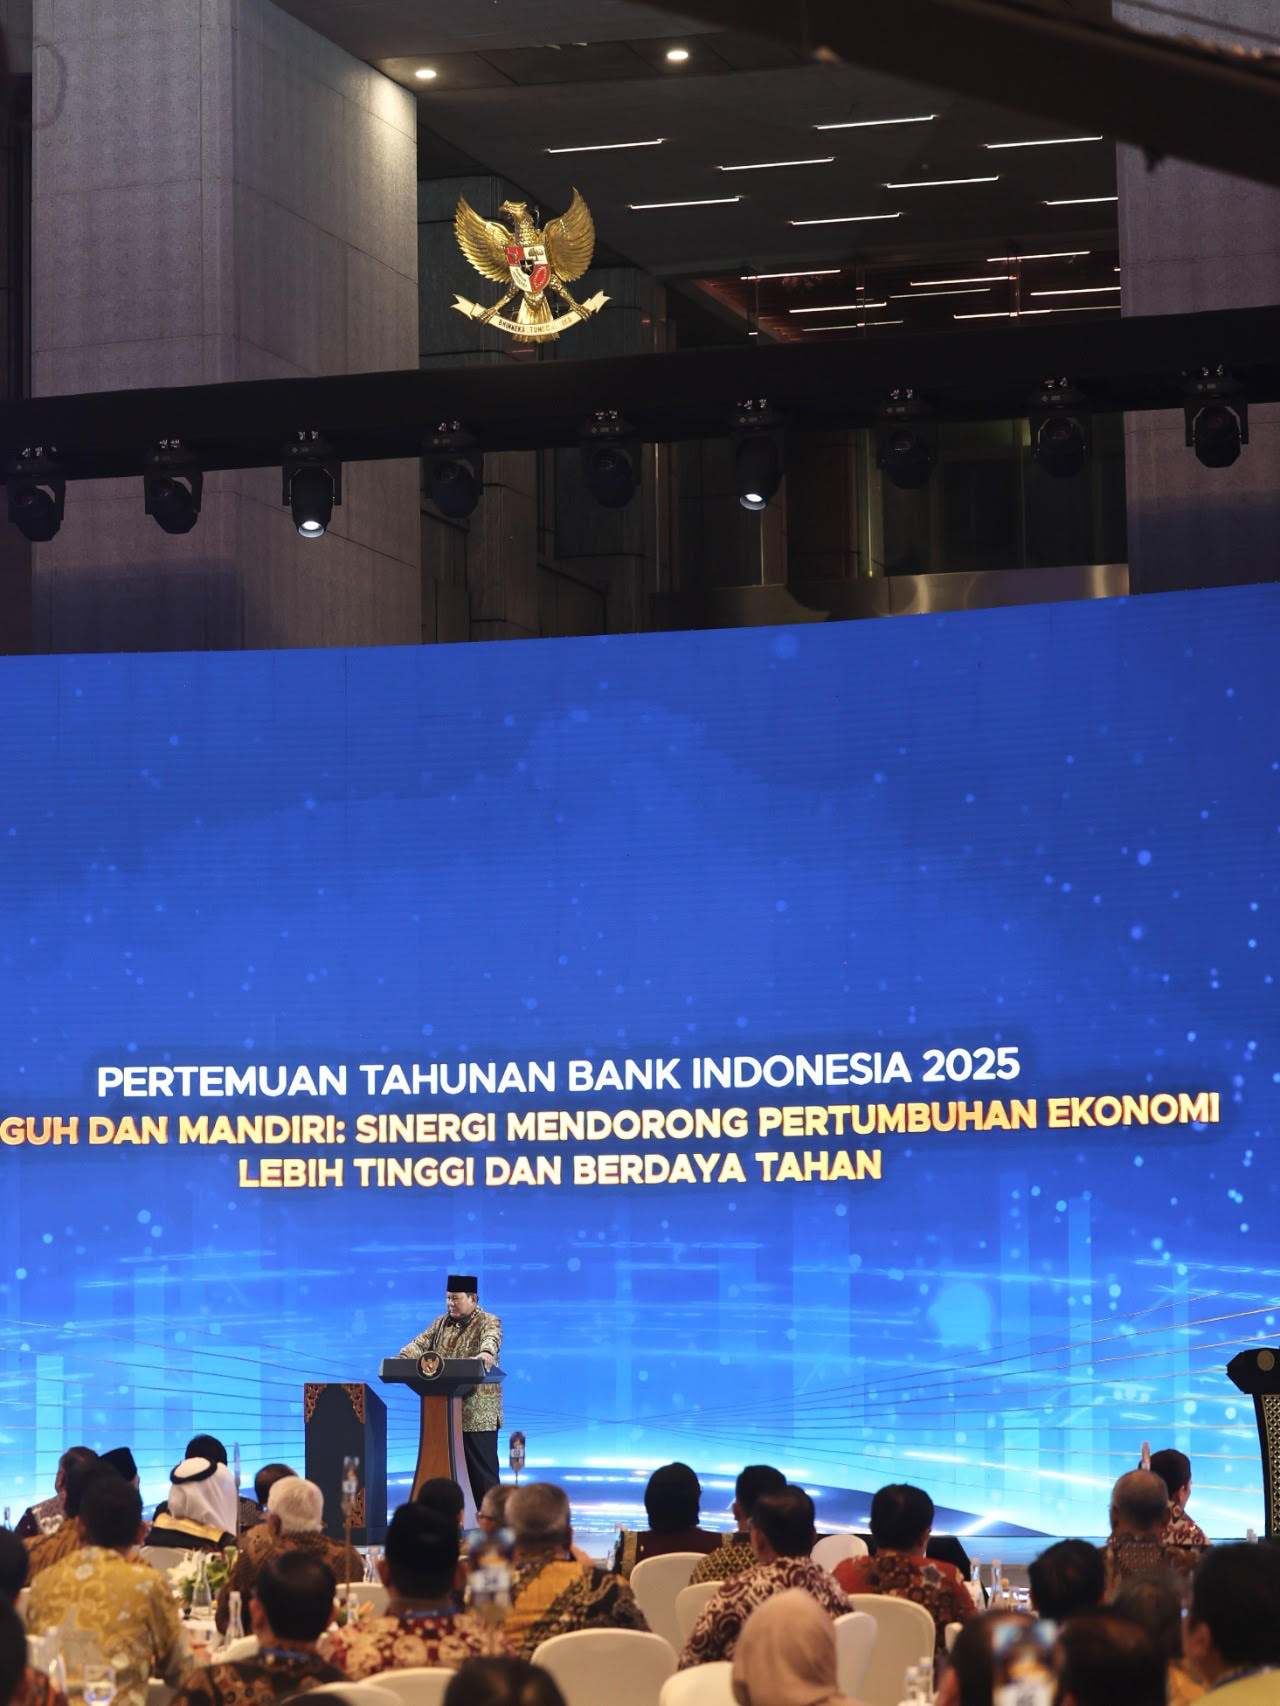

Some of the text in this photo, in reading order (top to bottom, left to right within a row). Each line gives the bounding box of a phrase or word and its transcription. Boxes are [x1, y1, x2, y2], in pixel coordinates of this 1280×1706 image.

[98, 1046, 1021, 1097] PERTEMUAN TAHUNAN BANK INDONESIA 2025
[88, 1115, 169, 1145] DAN
[178, 1113, 346, 1145] MANDIRI:
[355, 1112, 496, 1144] SINERGI
[507, 1106, 749, 1142] MENDORONG
[758, 1098, 1038, 1138] PERTUMBUHAN
[1047, 1091, 1220, 1129] EKONOMI
[238, 1149, 882, 1188] LEBIH TINGGI DAN BERDAYA TAHAN
